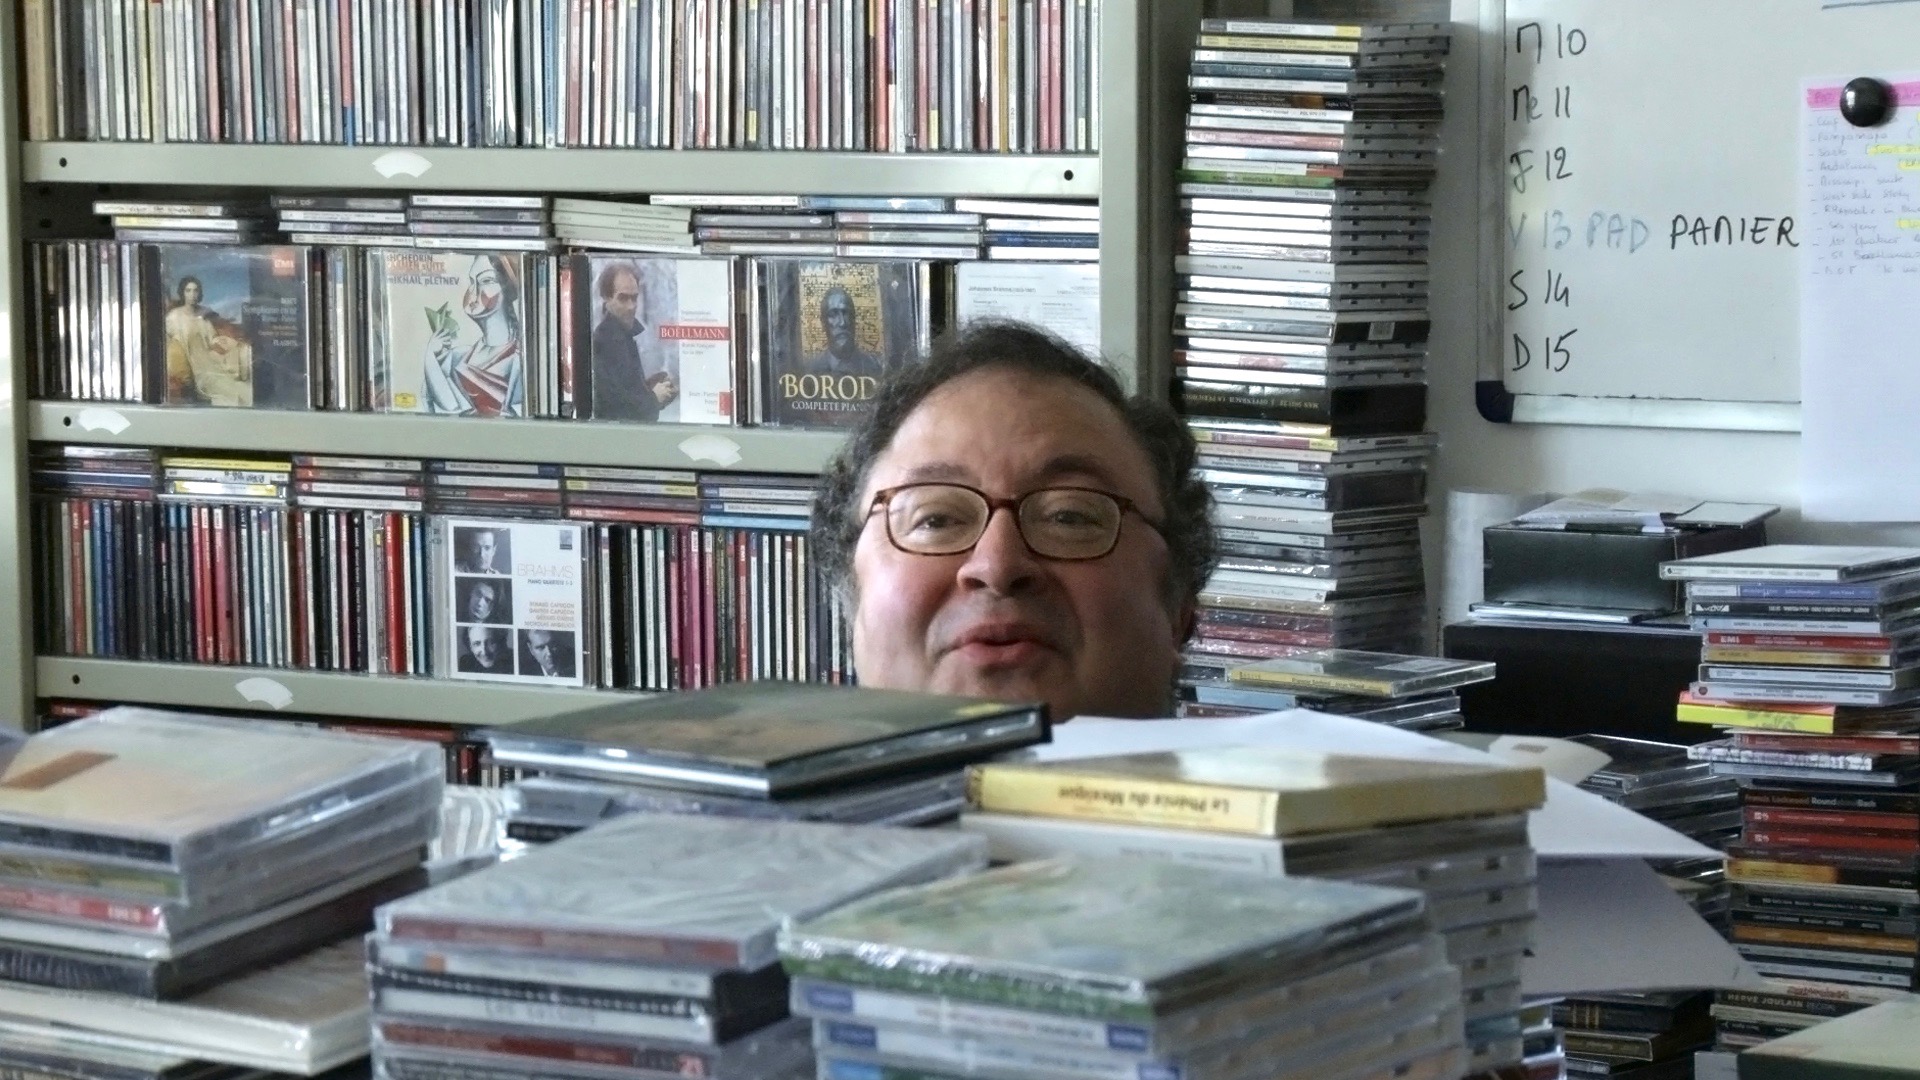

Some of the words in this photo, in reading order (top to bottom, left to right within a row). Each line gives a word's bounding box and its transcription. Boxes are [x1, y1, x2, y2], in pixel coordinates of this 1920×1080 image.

[1557, 23, 1587, 59] 10
[1555, 85, 1571, 118] 11
[1546, 146, 1573, 180] 12
[1508, 212, 1527, 249] V
[1543, 210, 1572, 249] 13
[1587, 210, 1649, 254] PAD
[1670, 213, 1800, 250] PANIER
[1507, 270, 1528, 311] S
[1544, 269, 1570, 307] 14
[1511, 333, 1531, 371] D
[1545, 328, 1578, 372] 15
[791, 401, 839, 411] COMPLETE
[517, 563, 574, 579] BRAHMS
[1720, 636, 1740, 644] EMI
[1762, 998, 1804, 1009] JOULAIN
